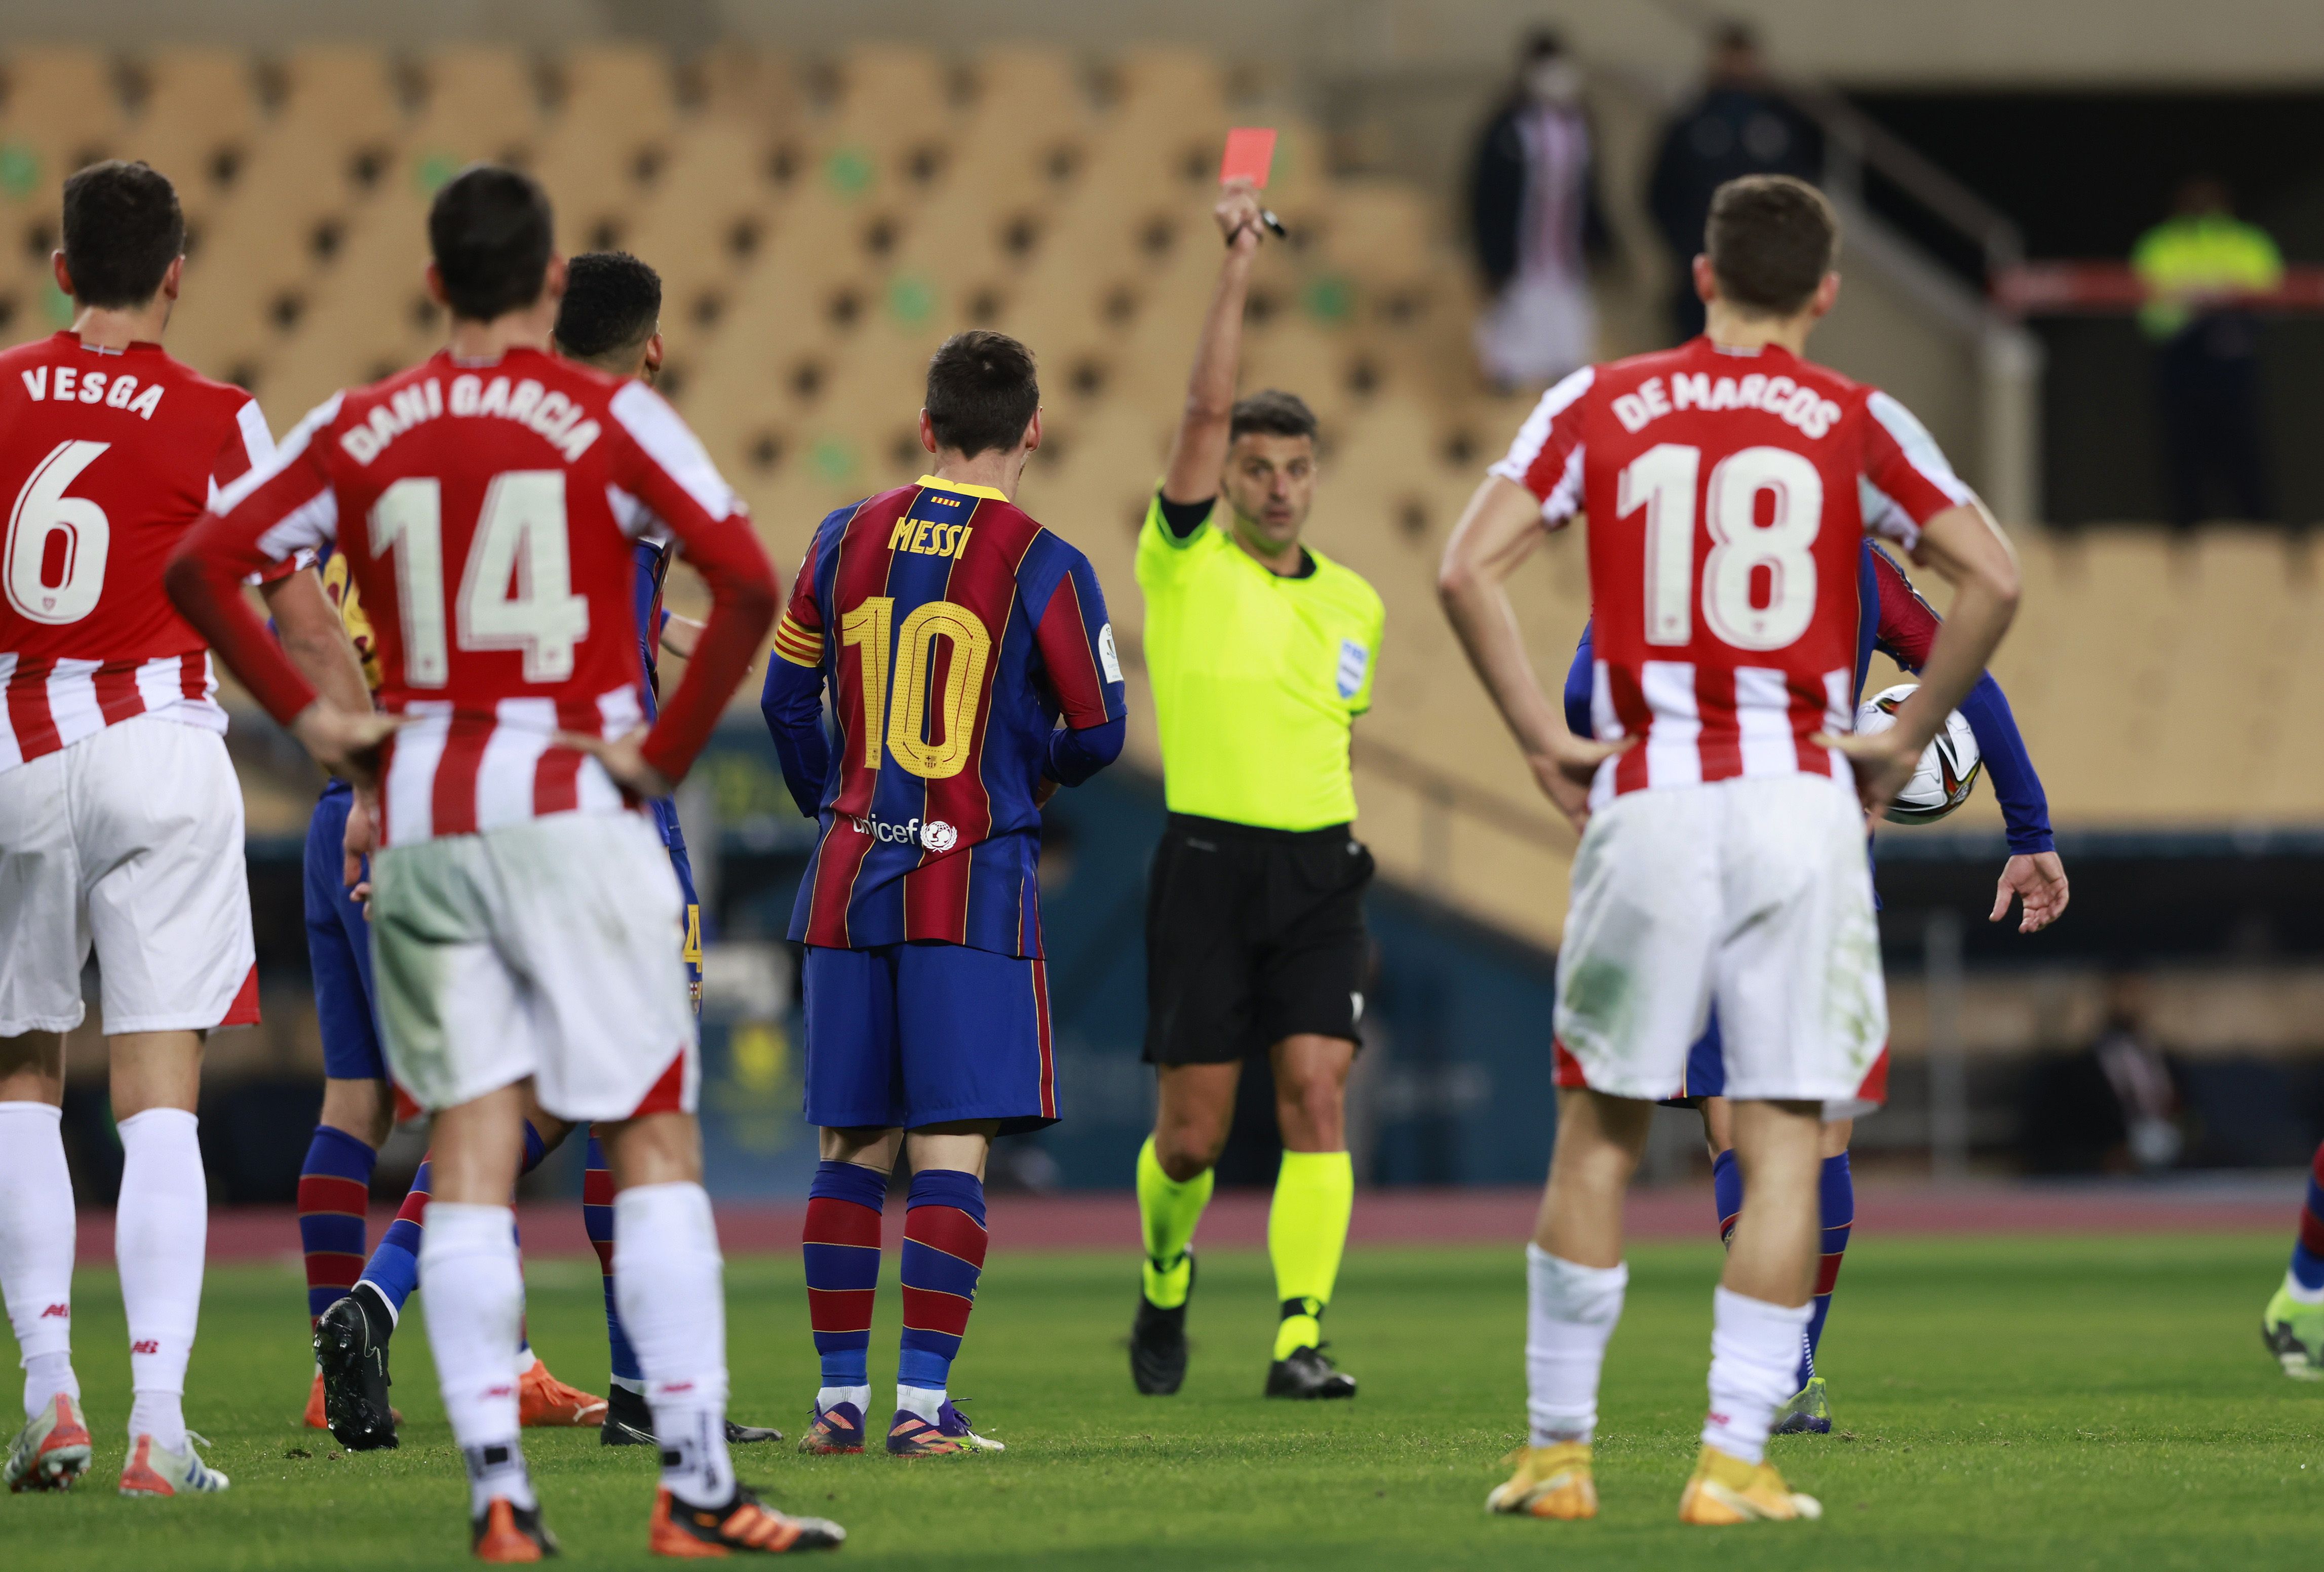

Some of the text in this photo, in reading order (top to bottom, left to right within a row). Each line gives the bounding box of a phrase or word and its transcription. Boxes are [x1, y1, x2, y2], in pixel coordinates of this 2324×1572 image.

[21, 366, 165, 420] VESGA
[340, 374, 602, 466] DANI GARCIA
[1611, 371, 1842, 440] DE MARCOS
[3, 439, 111, 625] 6
[887, 517, 973, 559] MESSI
[1616, 443, 1822, 651] 18
[367, 468, 589, 689] 14
[842, 597, 992, 778] 10
[848, 814, 919, 845] unicef
